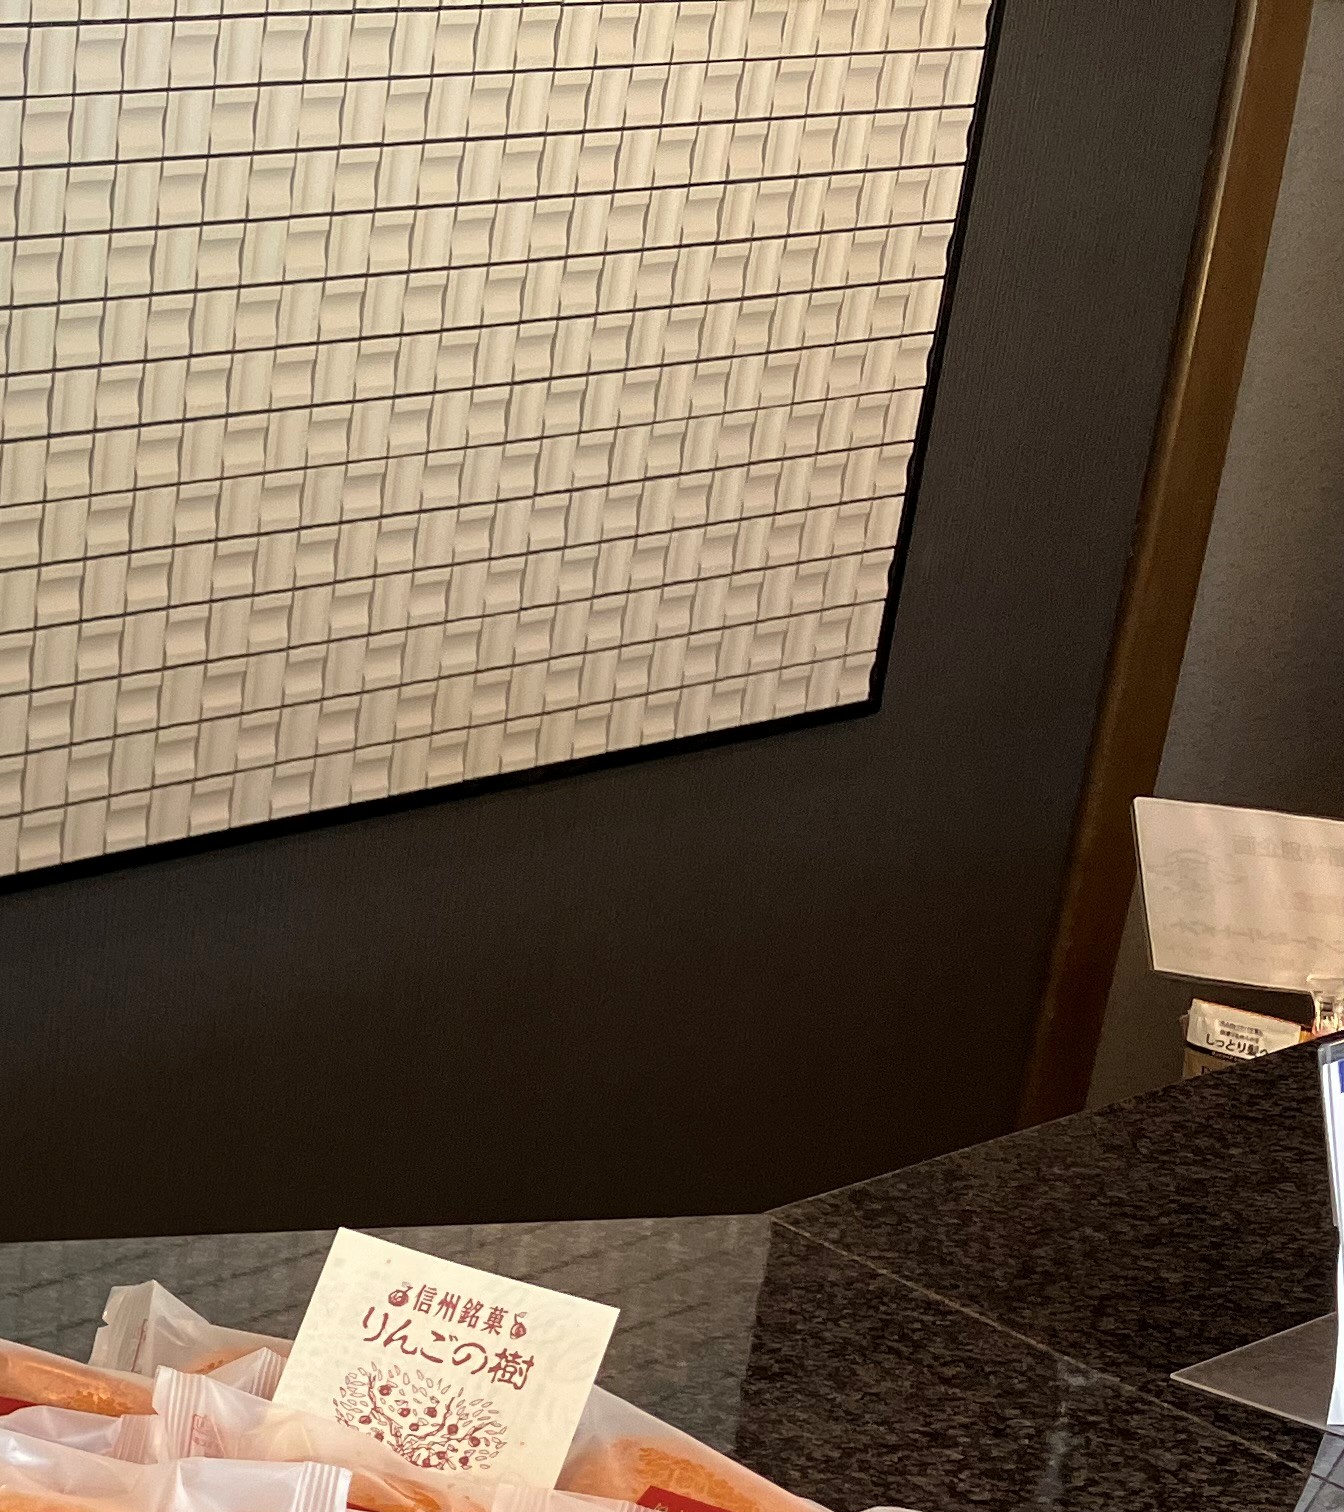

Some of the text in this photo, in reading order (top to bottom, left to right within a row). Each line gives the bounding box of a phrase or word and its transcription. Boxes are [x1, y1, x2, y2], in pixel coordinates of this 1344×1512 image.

[413, 1283, 509, 1337] 信州銘菓
[363, 1306, 535, 1391] りんごの樹
